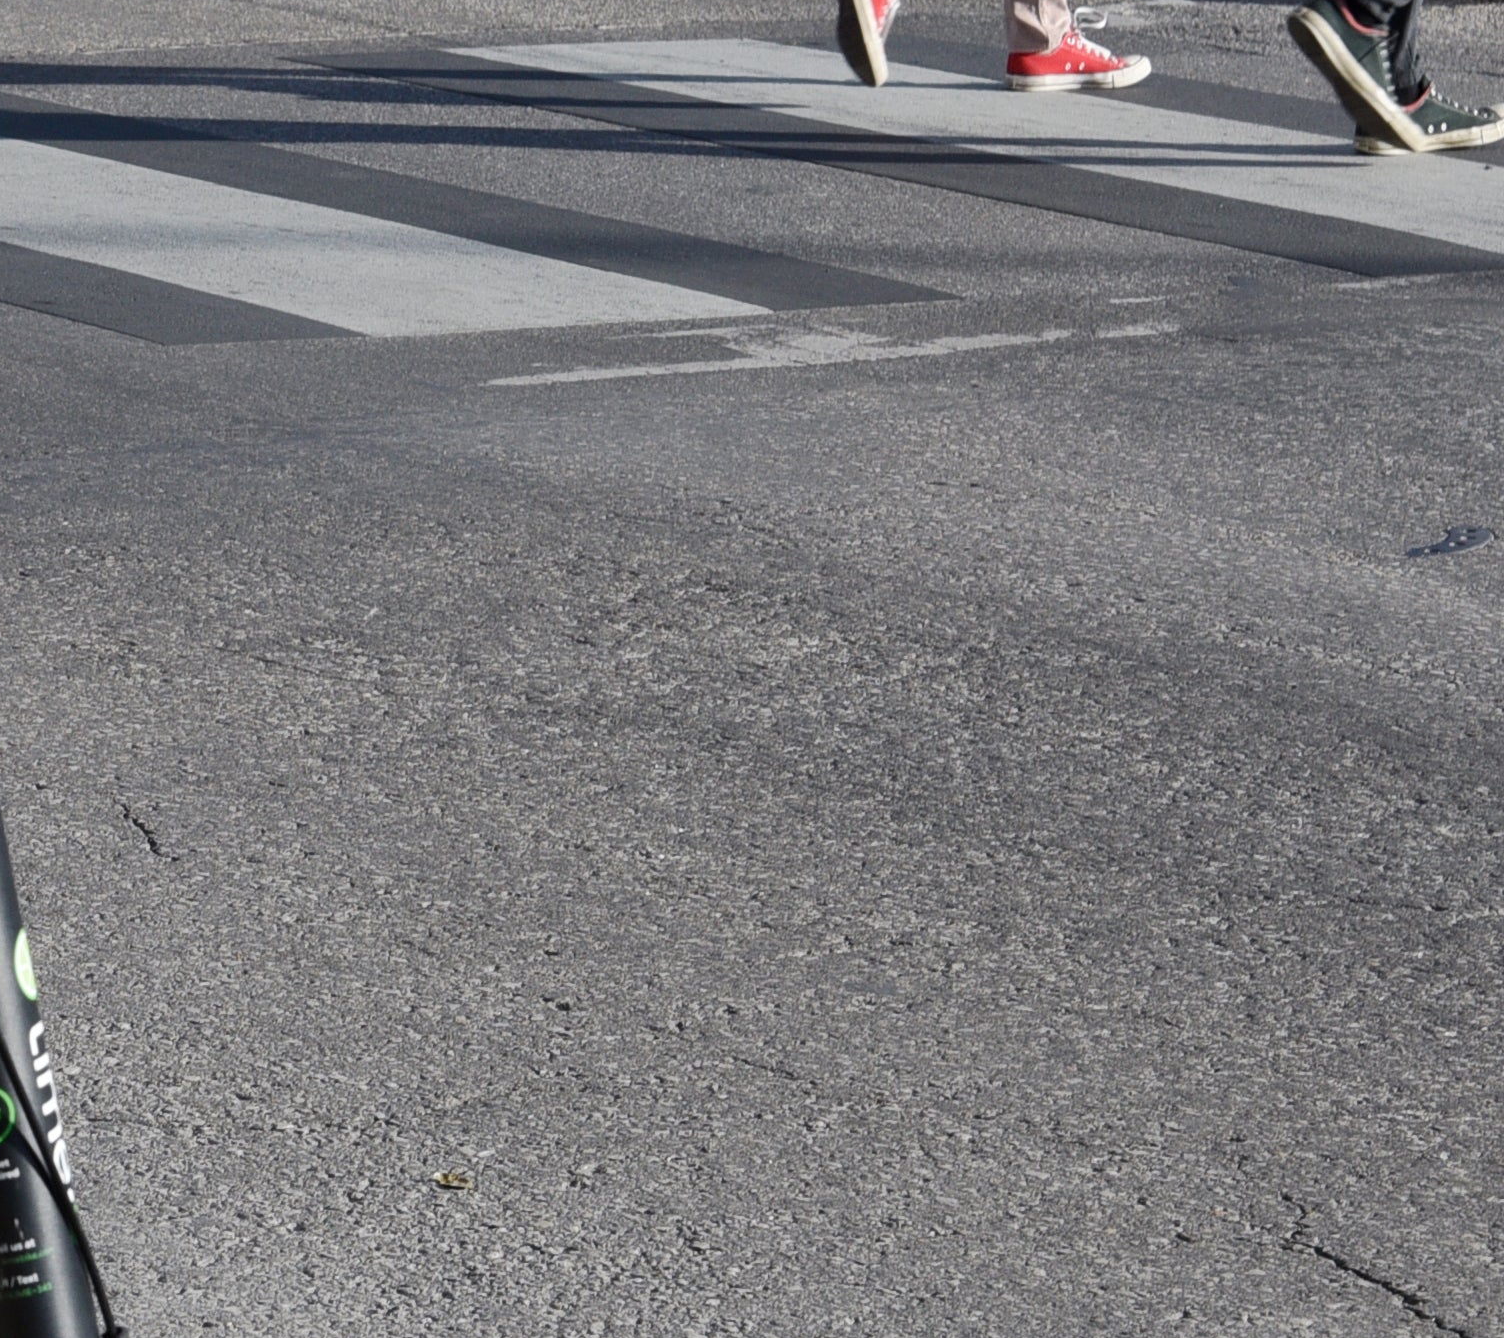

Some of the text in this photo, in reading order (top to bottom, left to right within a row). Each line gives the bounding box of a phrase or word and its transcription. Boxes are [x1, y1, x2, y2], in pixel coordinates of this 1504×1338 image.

[10, 1238, 36, 1252] us at
[16, 1272, 39, 1285] Text
